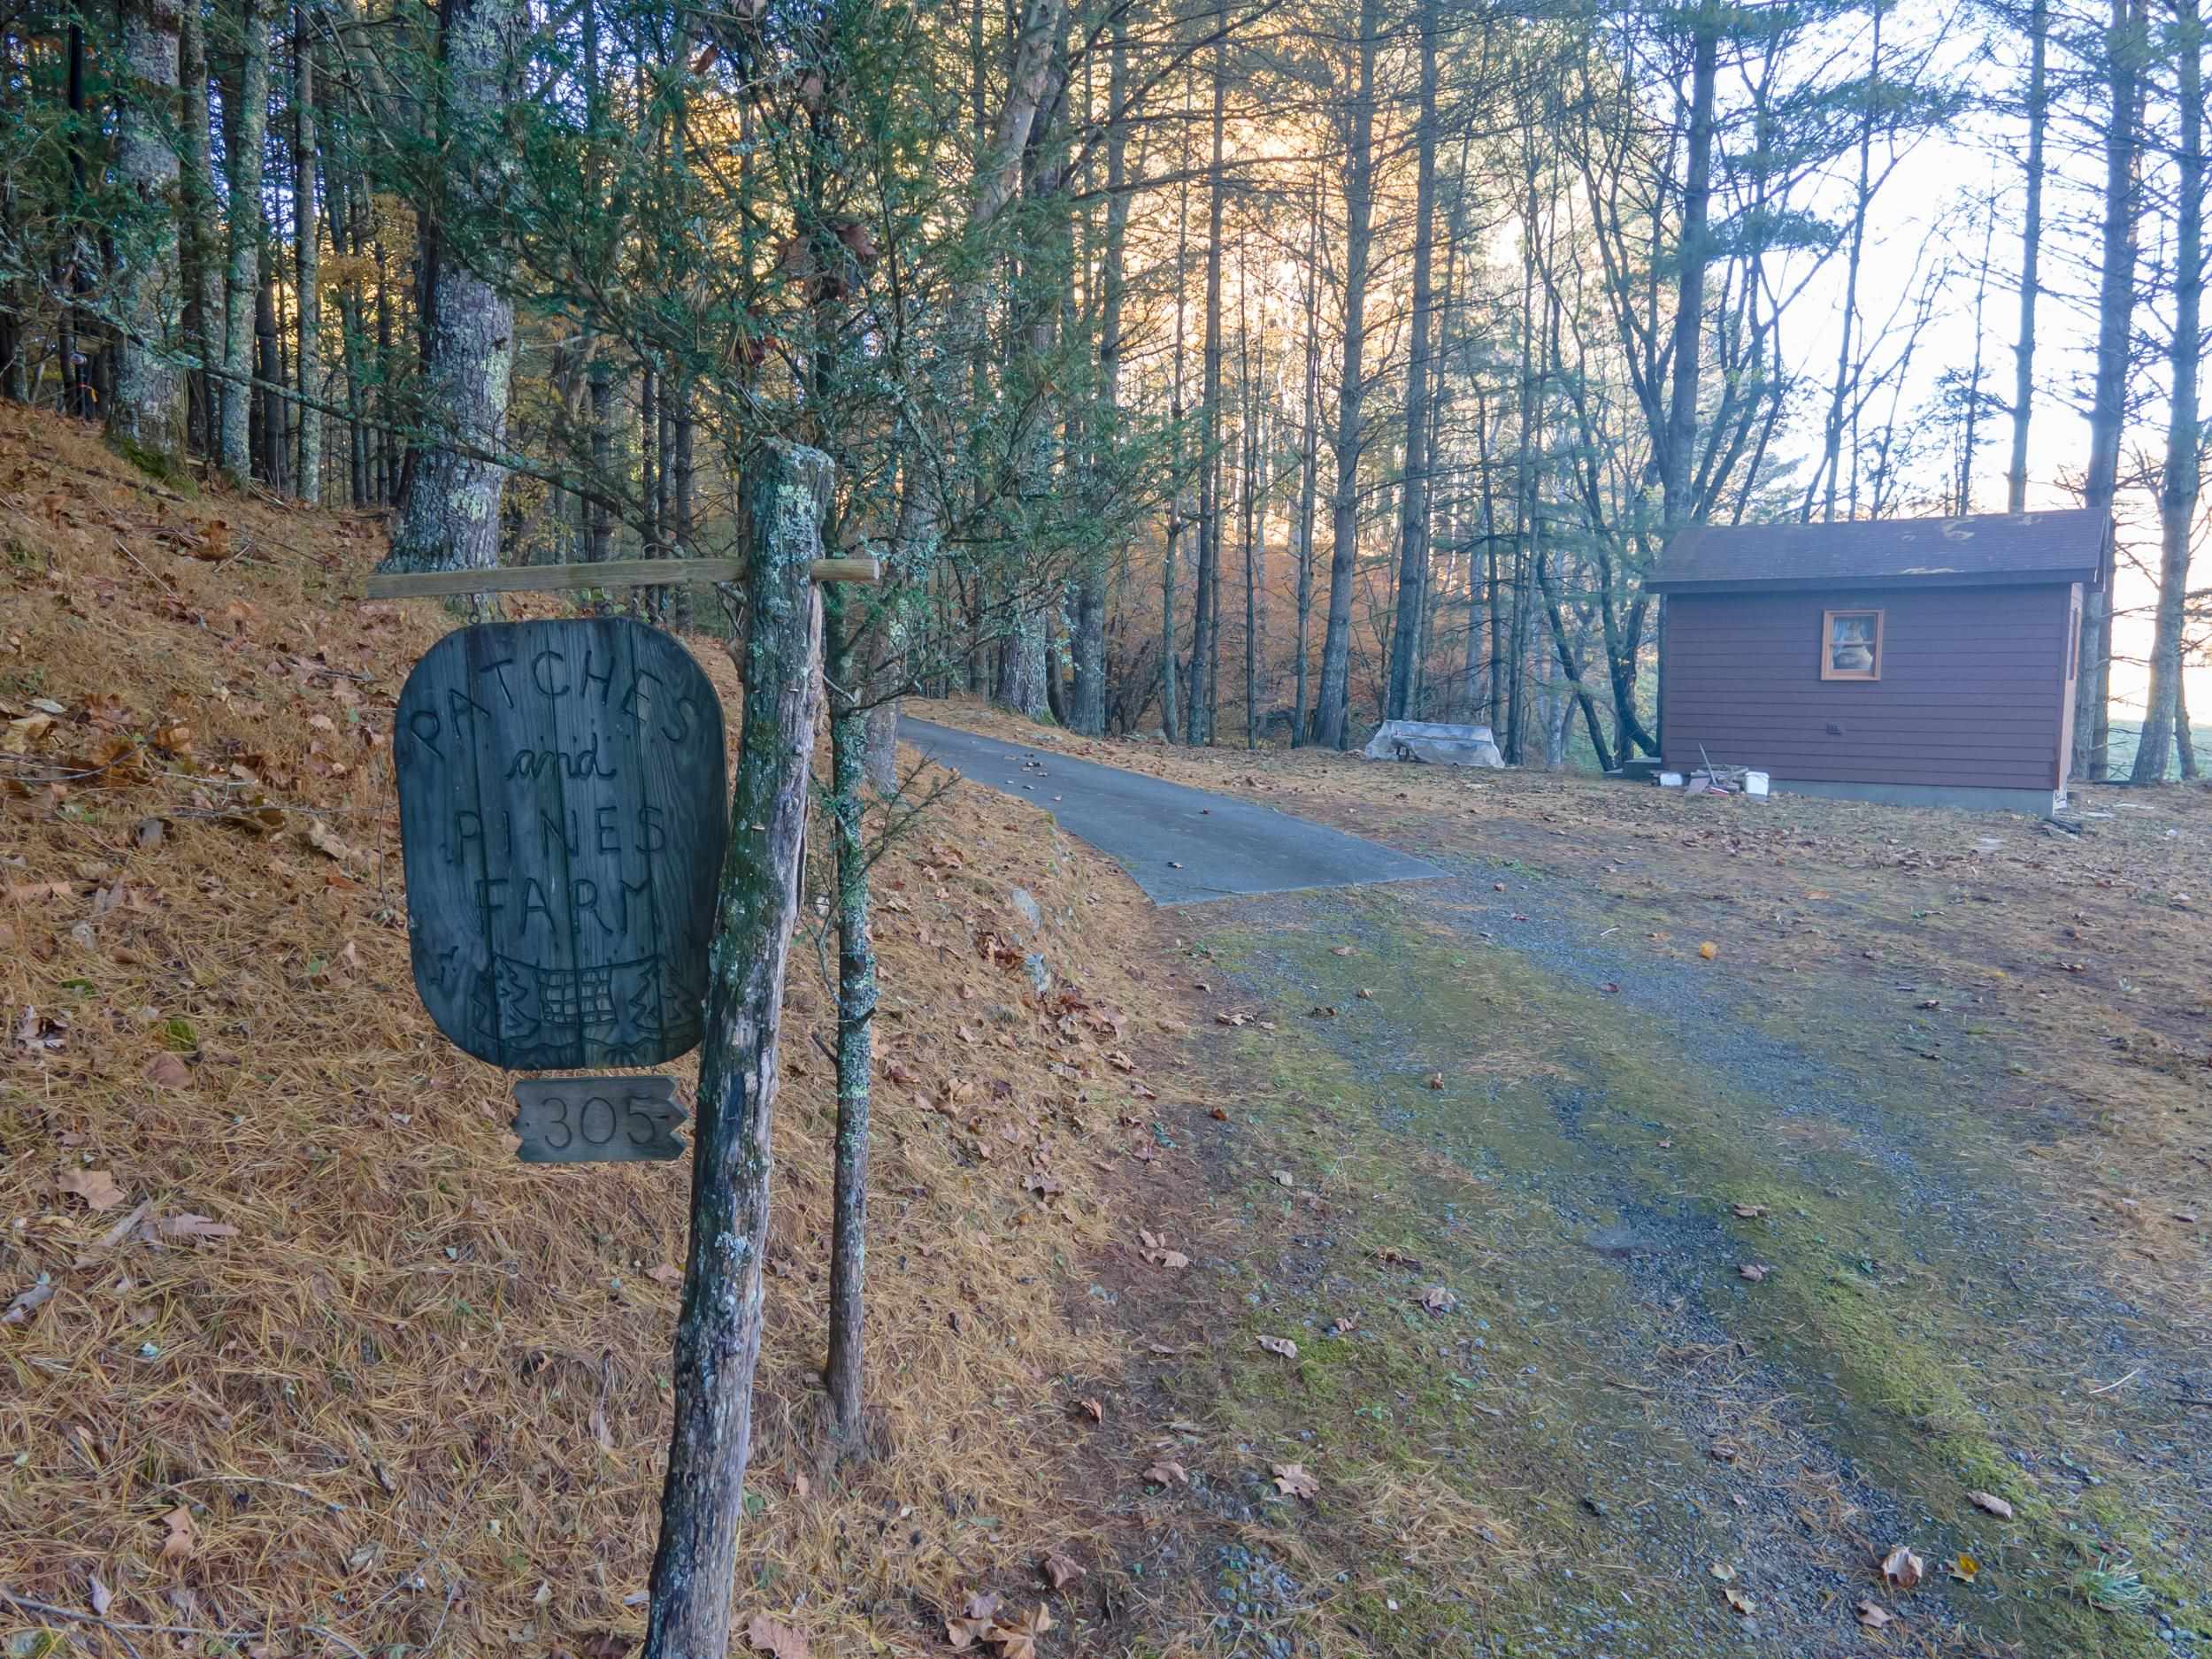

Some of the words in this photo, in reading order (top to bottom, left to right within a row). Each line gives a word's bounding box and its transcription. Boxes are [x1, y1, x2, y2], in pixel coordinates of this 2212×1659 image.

[410, 649, 699, 761] PATCHES
[505, 730, 617, 780] and
[455, 806, 666, 864] PINES
[474, 877, 661, 935] FARM
[541, 1094, 657, 1148] 305
